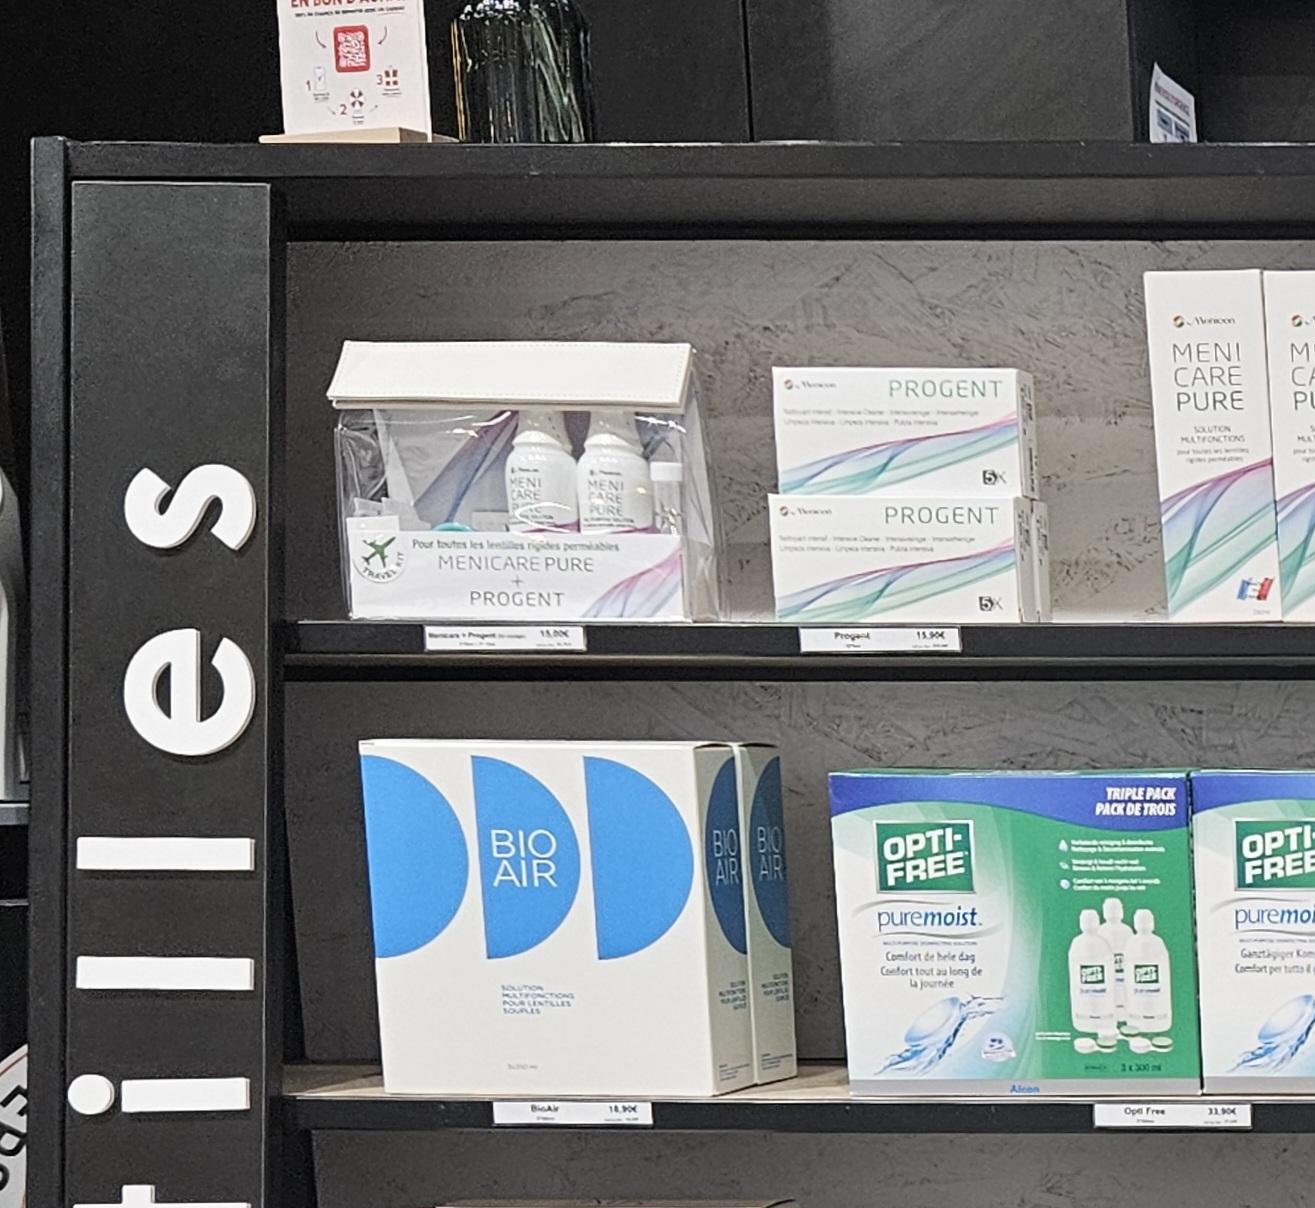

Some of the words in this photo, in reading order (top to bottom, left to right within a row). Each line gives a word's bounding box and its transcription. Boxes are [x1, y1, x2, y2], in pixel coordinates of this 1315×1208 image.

[1174, 343, 1241, 362] MENI
[1175, 367, 1241, 386] CARE
[889, 380, 1002, 398] PROGENT
[1177, 390, 1244, 411] PURE
[885, 506, 998, 524] PROGENT
[413, 539, 434, 550] Pour
[437, 540, 466, 550] toutes
[470, 540, 483, 550] les
[487, 540, 524, 550] lentilles
[527, 541, 560, 552] rigides
[563, 541, 619, 552] perméables
[439, 556, 539, 571] MENICARE
[545, 557, 594, 572] PURE
[471, 592, 564, 607] PROGENT
[835, 632, 870, 641] Progent
[1106, 787, 1144, 800] TRIPLE
[1146, 787, 1176, 801] PACK
[1096, 803, 1124, 816] PACK
[1125, 803, 1141, 816] DE
[1142, 802, 1176, 816] TROIS
[491, 829, 557, 859] BIO
[883, 828, 962, 861] OPTI-
[493, 860, 557, 888] AIR
[886, 852, 965, 886] FREE
[878, 907, 978, 932] puremoist
[886, 952, 921, 962] Comfort
[924, 952, 934, 962] de
[937, 951, 956, 962] hele
[959, 952, 975, 964] dag
[881, 967, 912, 977] Confort
[915, 967, 934, 977] tout
[936, 969, 947, 977] au
[949, 967, 968, 979] long
[971, 966, 982, 976] de
[910, 978, 917, 988] la
[919, 978, 954, 991] journée
